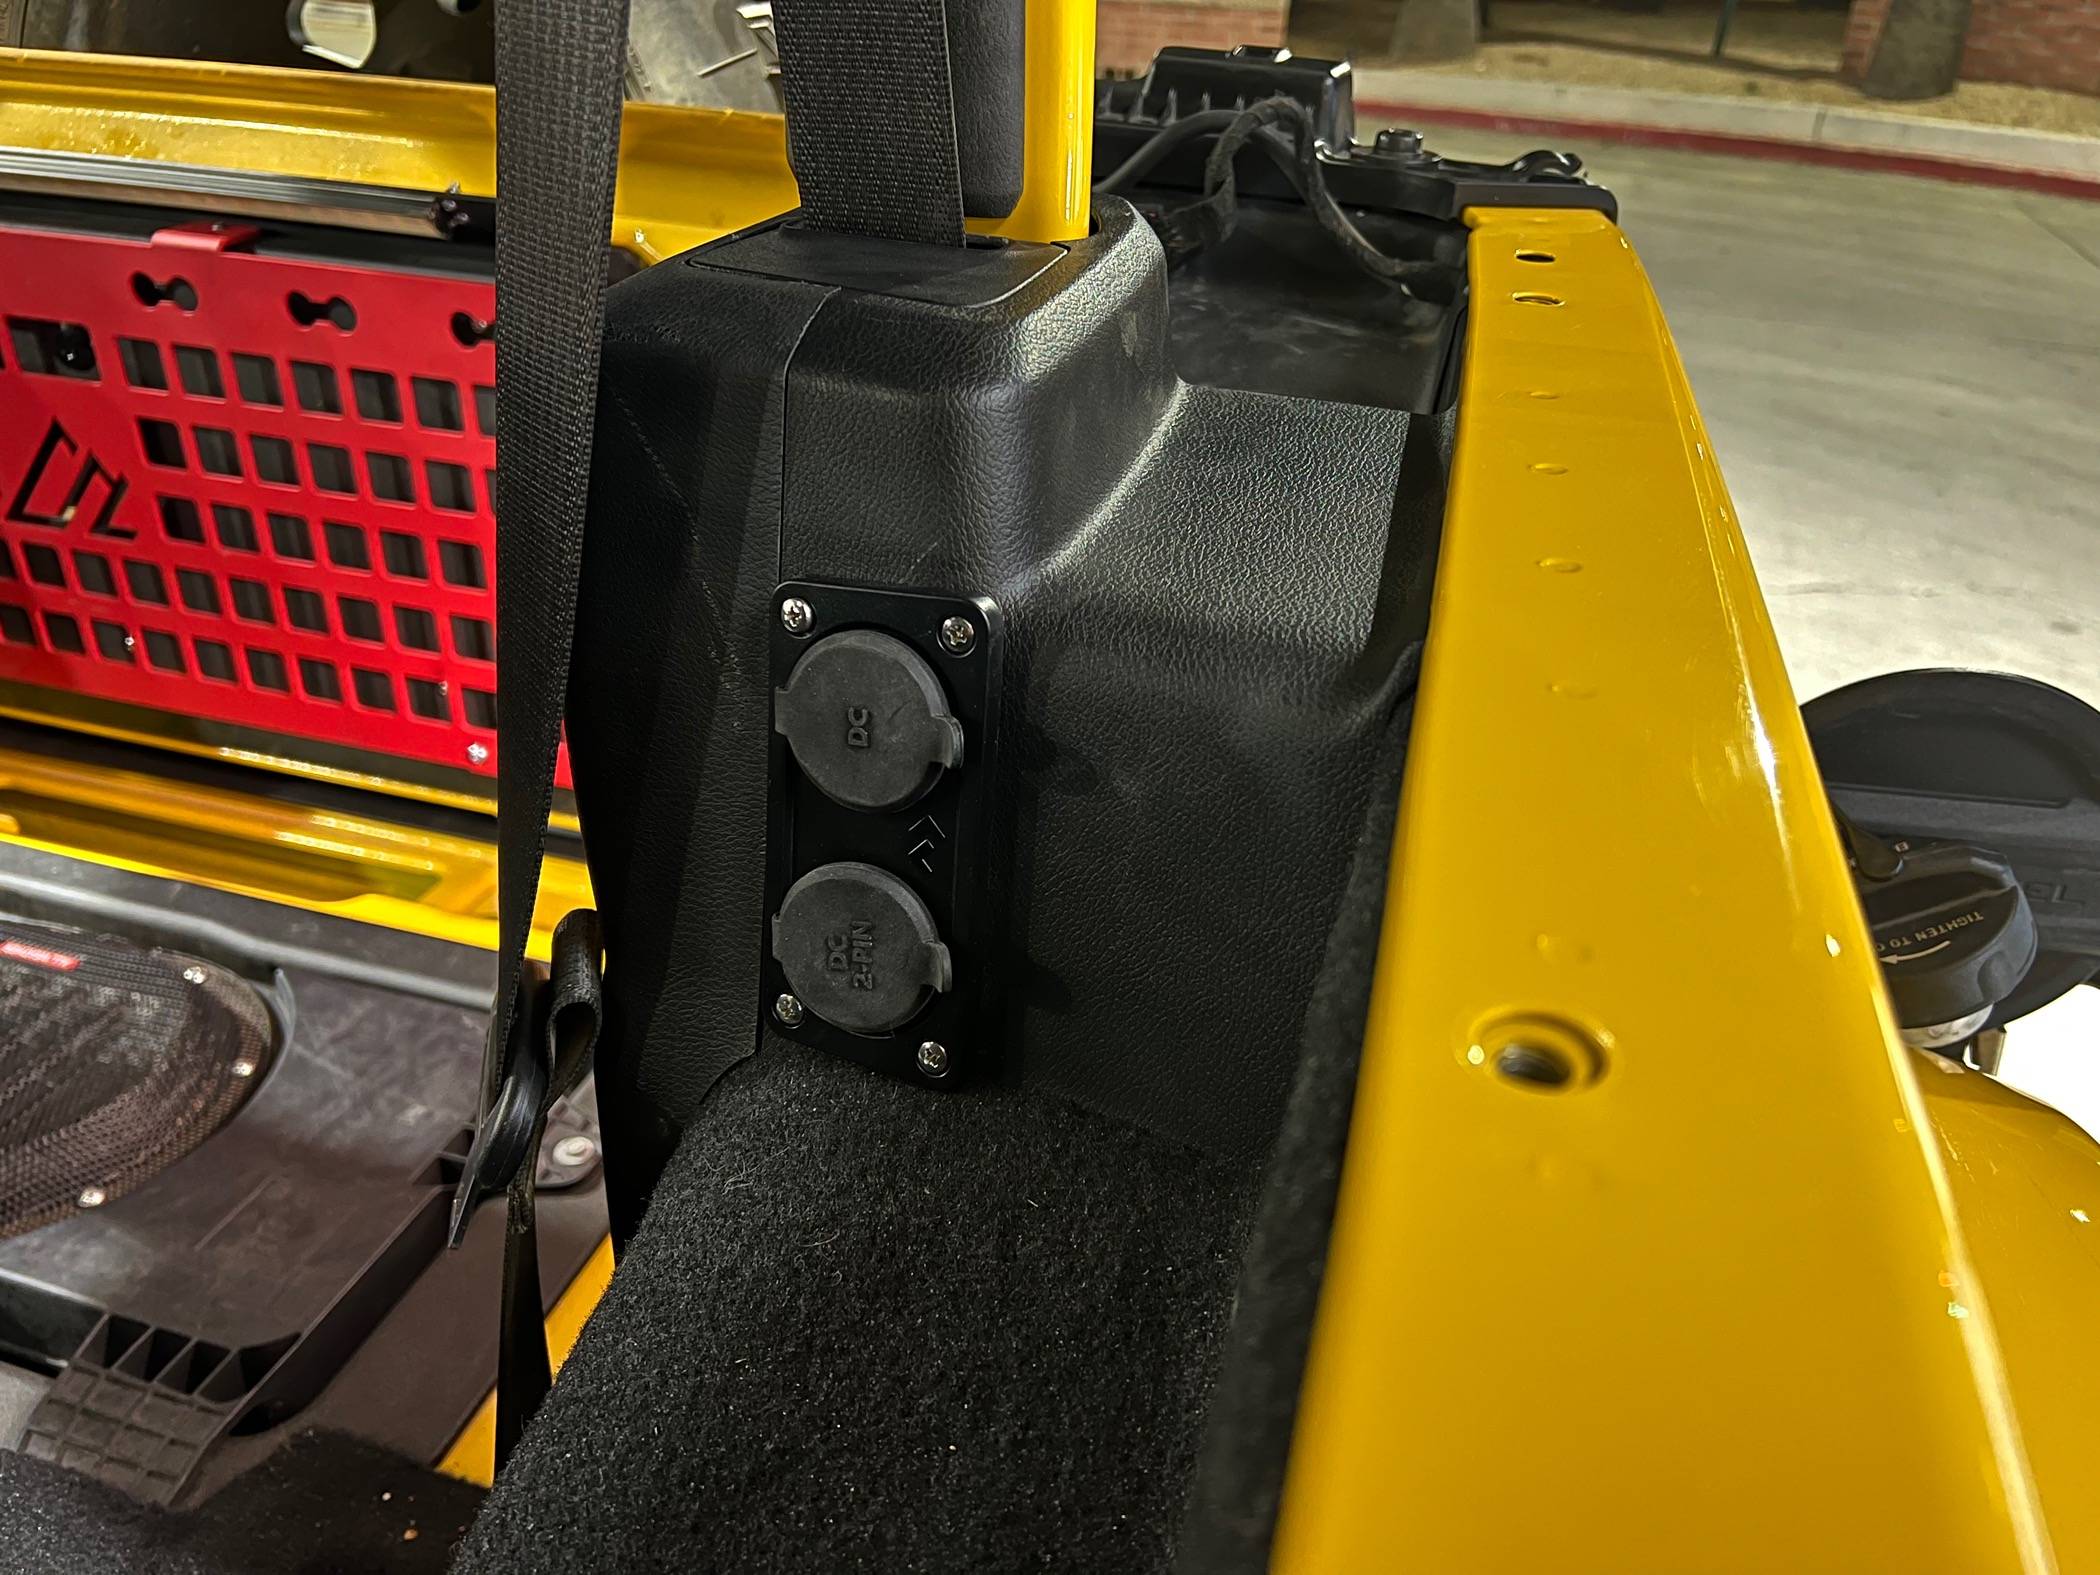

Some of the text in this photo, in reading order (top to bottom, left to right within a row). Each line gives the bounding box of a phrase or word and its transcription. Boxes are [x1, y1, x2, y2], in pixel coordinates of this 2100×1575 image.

[848, 706, 869, 747] DC
[1889, 936, 1913, 949] TO
[1914, 911, 1985, 942] TIGHTEN
[827, 933, 849, 972] DC
[851, 920, 873, 990] 2-PIN
